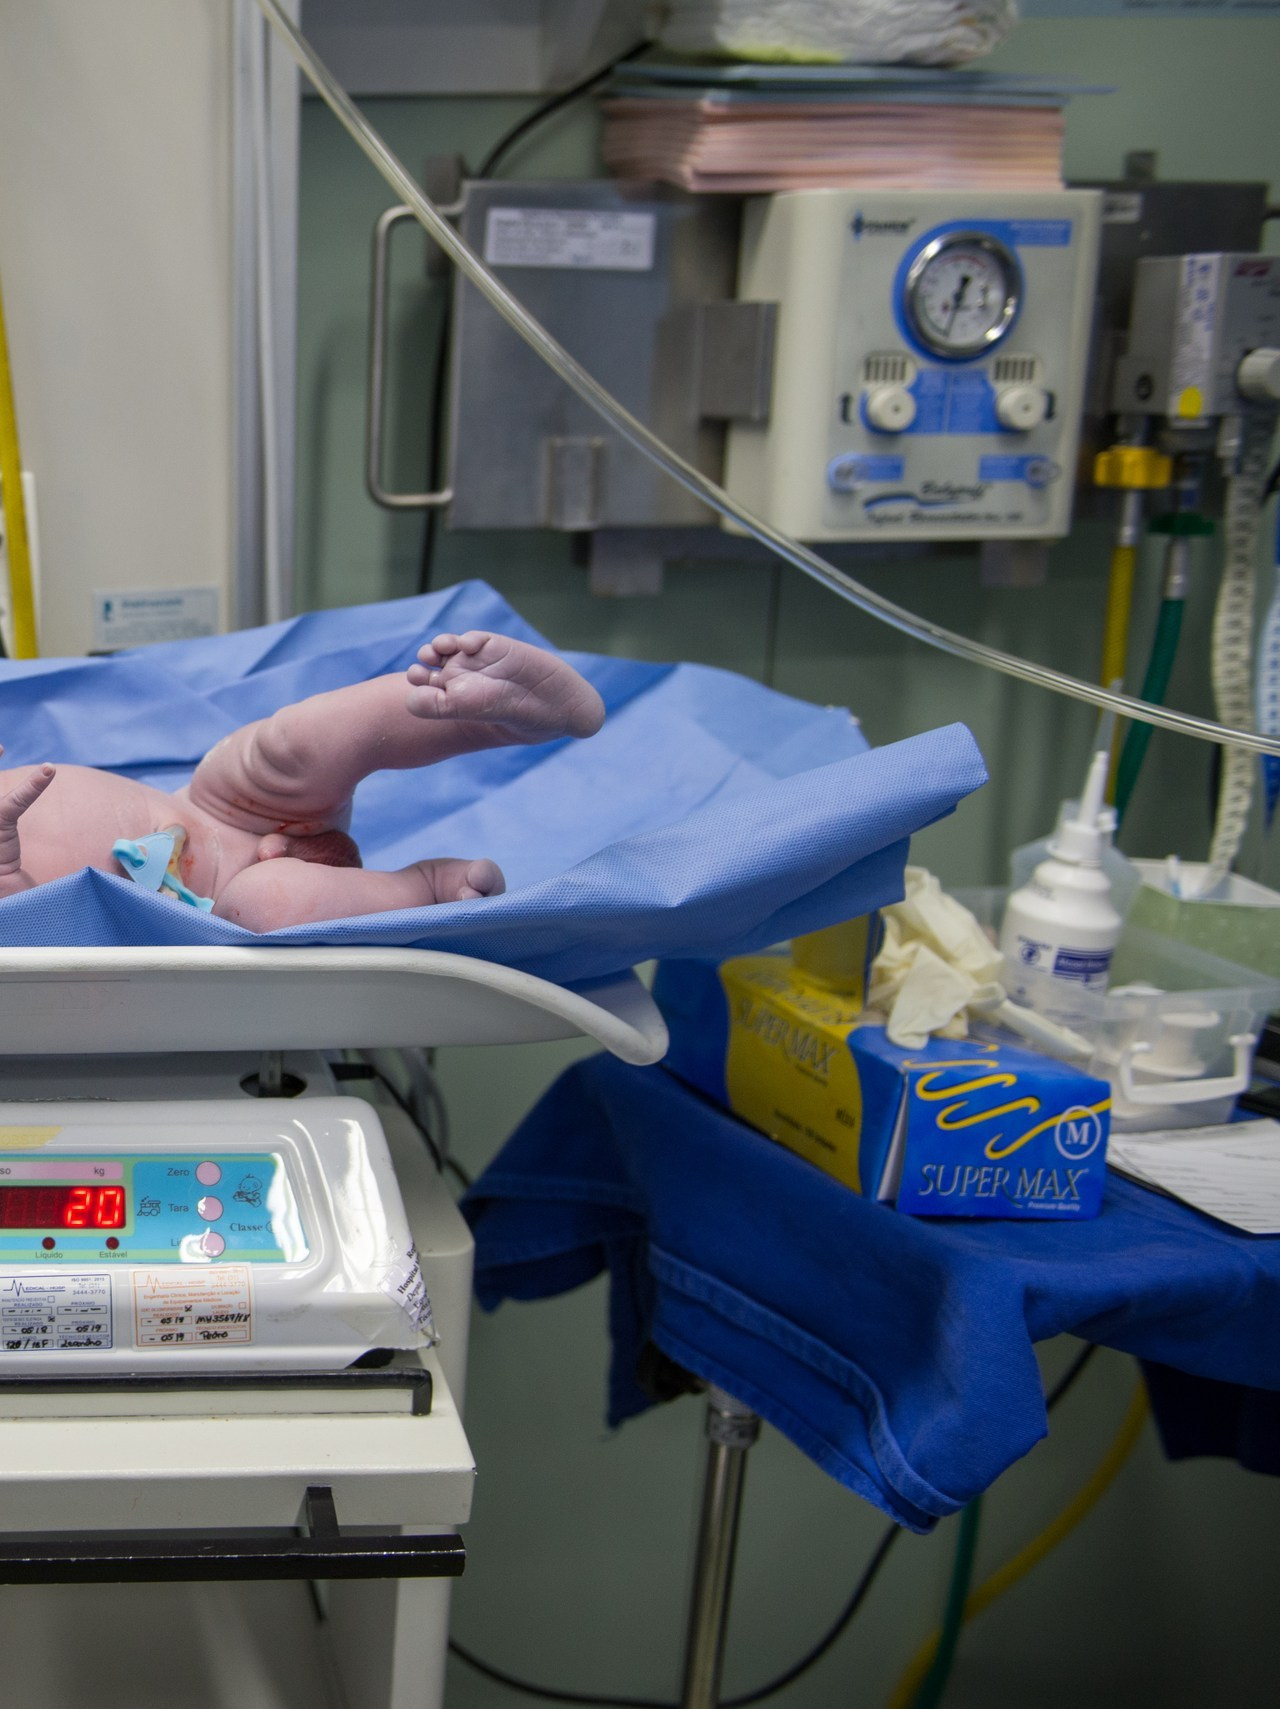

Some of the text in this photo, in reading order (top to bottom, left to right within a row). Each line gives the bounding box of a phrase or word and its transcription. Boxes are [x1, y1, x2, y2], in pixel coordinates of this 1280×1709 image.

[1065, 1121, 1091, 1145] M
[93, 1166, 105, 1177] kg
[167, 1167, 190, 1177] Zero
[918, 1164, 1086, 1203] SUPER MAX
[66, 1189, 122, 1225] 20
[168, 1203, 190, 1212] Tara
[229, 1222, 263, 1232] Classe
[397, 1265, 419, 1294] Hospital
